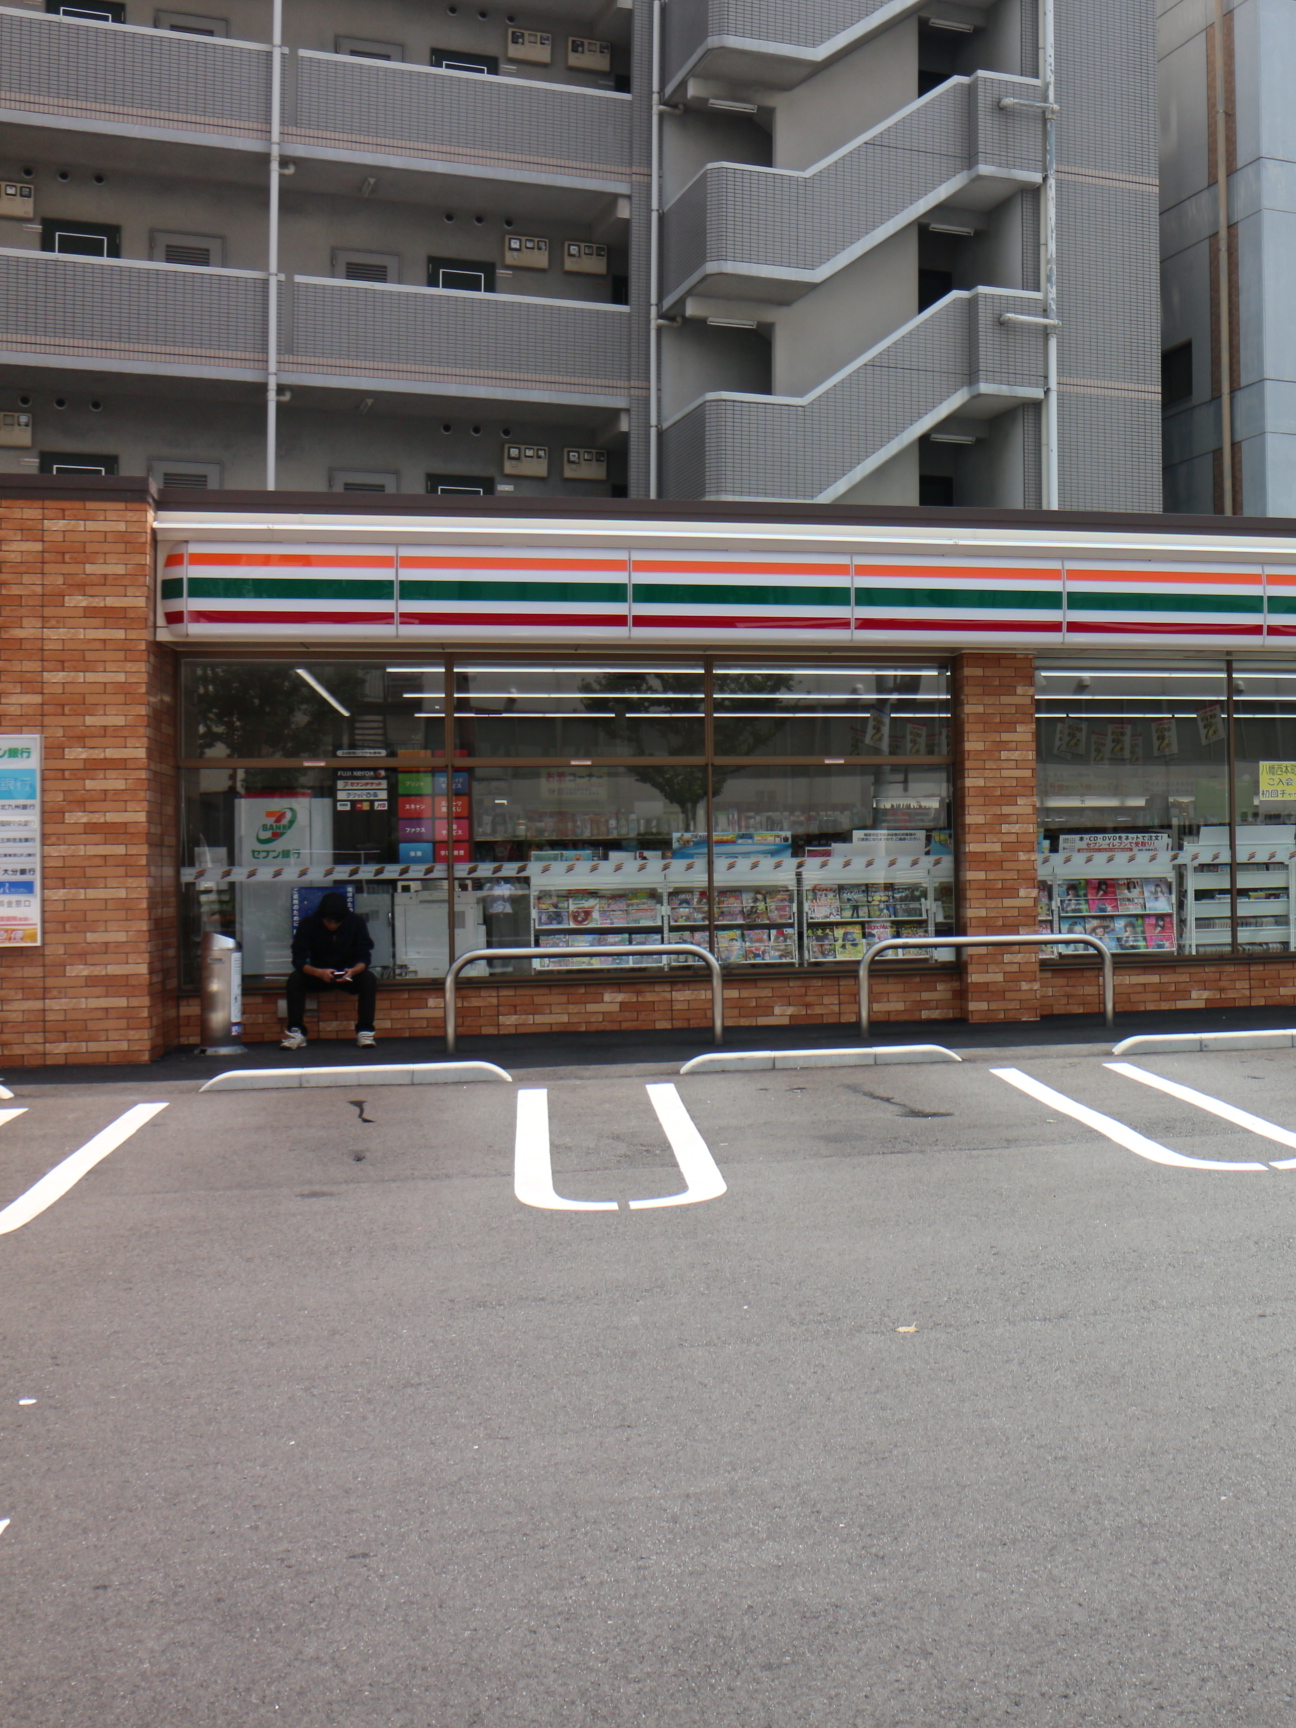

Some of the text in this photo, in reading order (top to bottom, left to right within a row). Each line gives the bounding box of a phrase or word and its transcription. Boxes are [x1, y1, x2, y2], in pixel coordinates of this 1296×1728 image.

[261, 824, 288, 832] BANK
[251, 849, 301, 859] セブン銀行
[2, 868, 35, 876] 大分銀行
